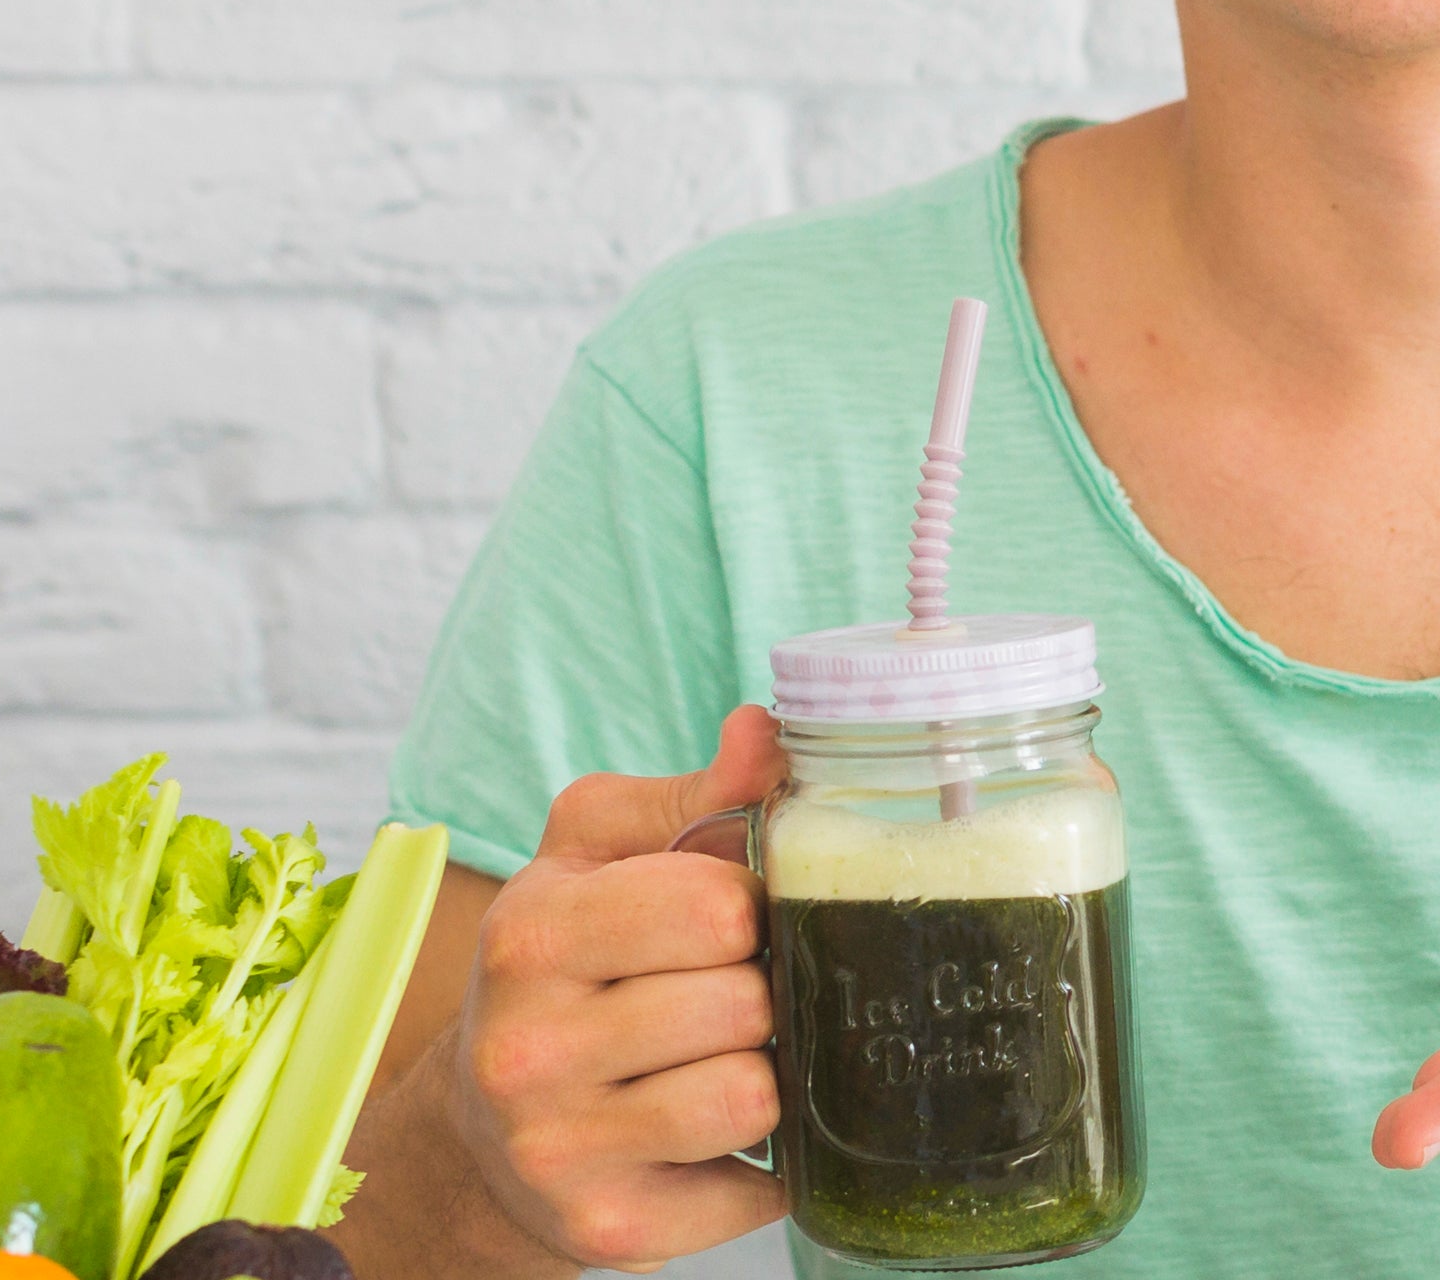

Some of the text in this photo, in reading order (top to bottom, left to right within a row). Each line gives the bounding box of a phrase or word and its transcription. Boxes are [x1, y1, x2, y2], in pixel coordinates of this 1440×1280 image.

[834, 954, 1039, 1030] Ice Cold
[862, 1022, 1021, 1087] Drink
